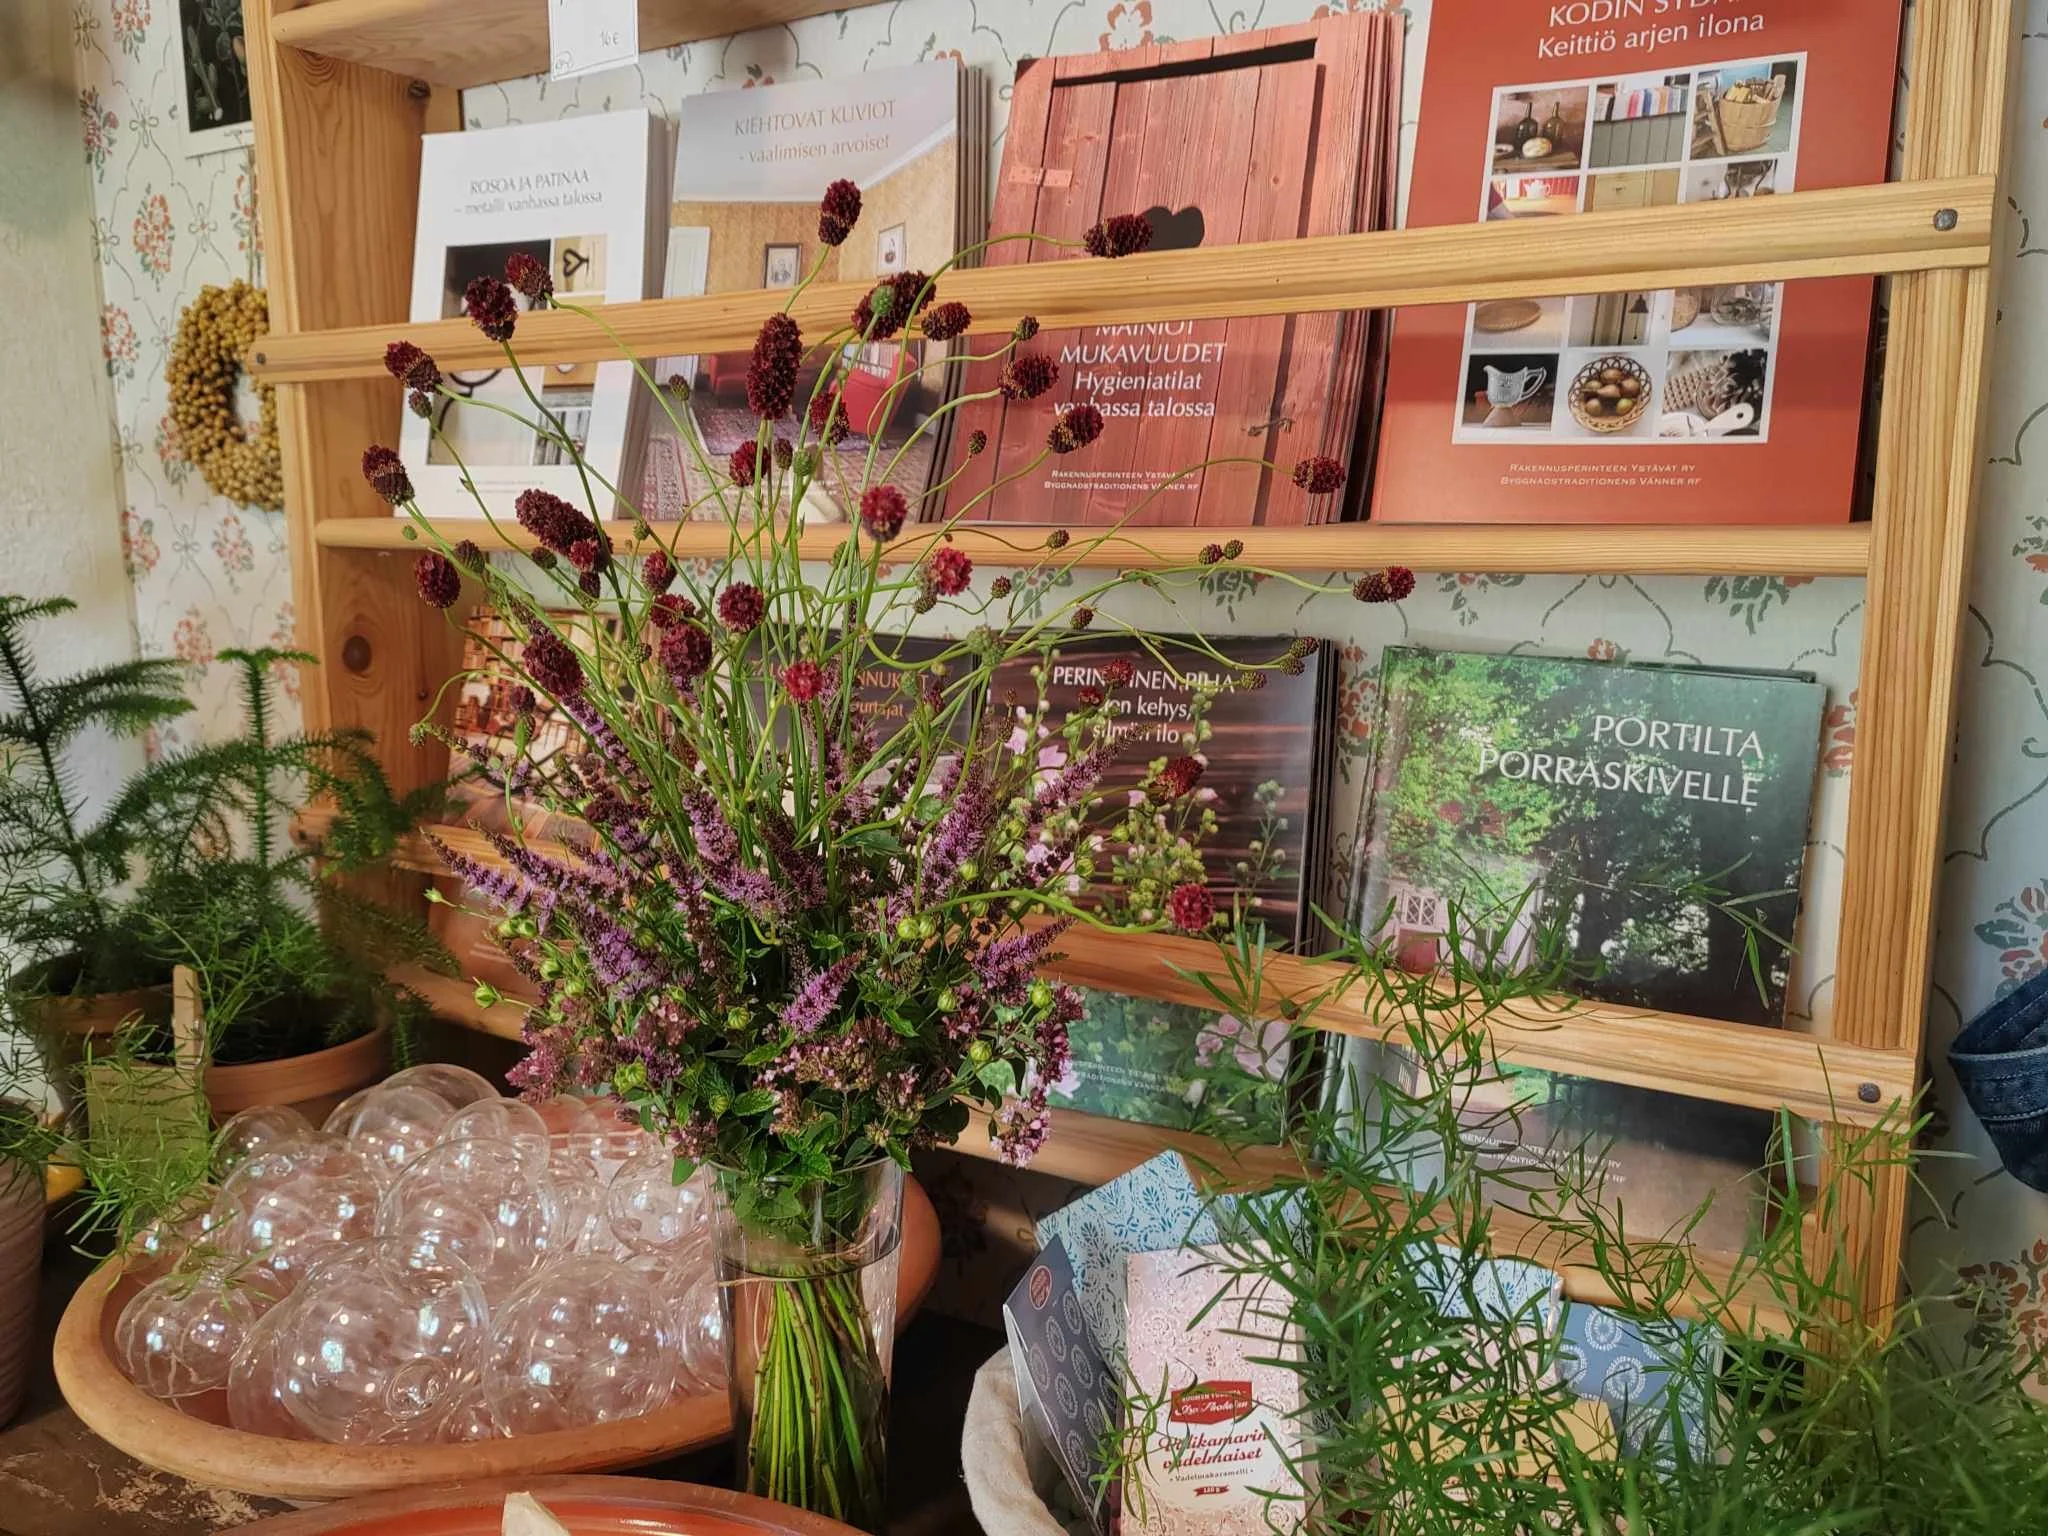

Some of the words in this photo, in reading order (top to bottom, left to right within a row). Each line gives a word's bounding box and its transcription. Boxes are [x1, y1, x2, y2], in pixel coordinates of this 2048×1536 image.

[1549, 0, 1644, 28] KODIN
[1538, 29, 1616, 59] Keittiö
[1624, 23, 1688, 53] arjen
[1699, 13, 1765, 38] ilona
[735, 110, 826, 136] KIEHTOVAT
[831, 99, 896, 125] KUVIOT
[749, 142, 827, 162] vaalimisen
[832, 135, 889, 155] arvoiset
[470, 177, 516, 194] ROSOA
[519, 176, 532, 191] JA
[508, 194, 560, 211] vanhassa
[563, 188, 602, 206] talossa
[1060, 343, 1227, 363] MUKAVUUDET
[1075, 369, 1202, 396] Hygieniatilat
[1148, 397, 1215, 416] talossa
[1137, 695, 1192, 723] kehys,
[1156, 723, 1180, 743] ilo
[1594, 714, 1764, 760] PORTILTA
[1479, 747, 1760, 806] PORRASKIVELLE
